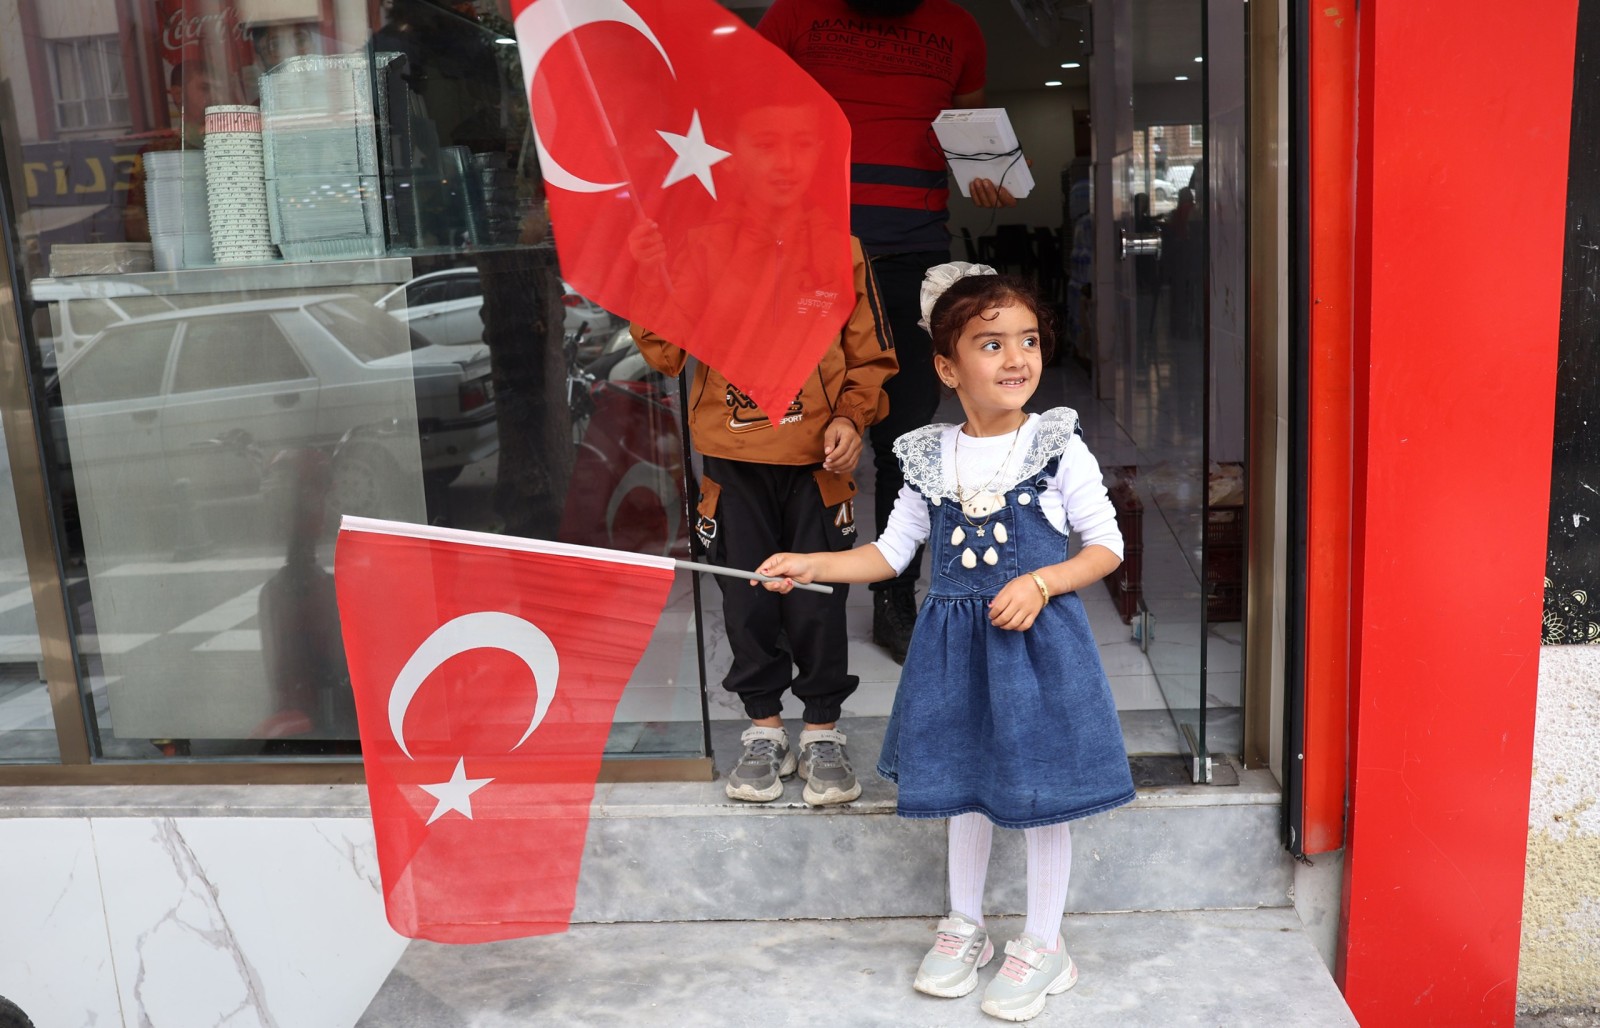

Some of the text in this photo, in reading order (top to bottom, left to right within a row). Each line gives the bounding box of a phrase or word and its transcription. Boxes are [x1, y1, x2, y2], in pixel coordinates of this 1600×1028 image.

[811, 18, 953, 53] MANHATTAN
[808, 32, 822, 43] IS
[826, 32, 860, 46] ONE
[864, 38, 887, 50] OF
[893, 43, 921, 57] THE
[926, 49, 953, 66] FIVE
[815, 290, 839, 299] SPORT
[779, 413, 803, 425] SPORT
